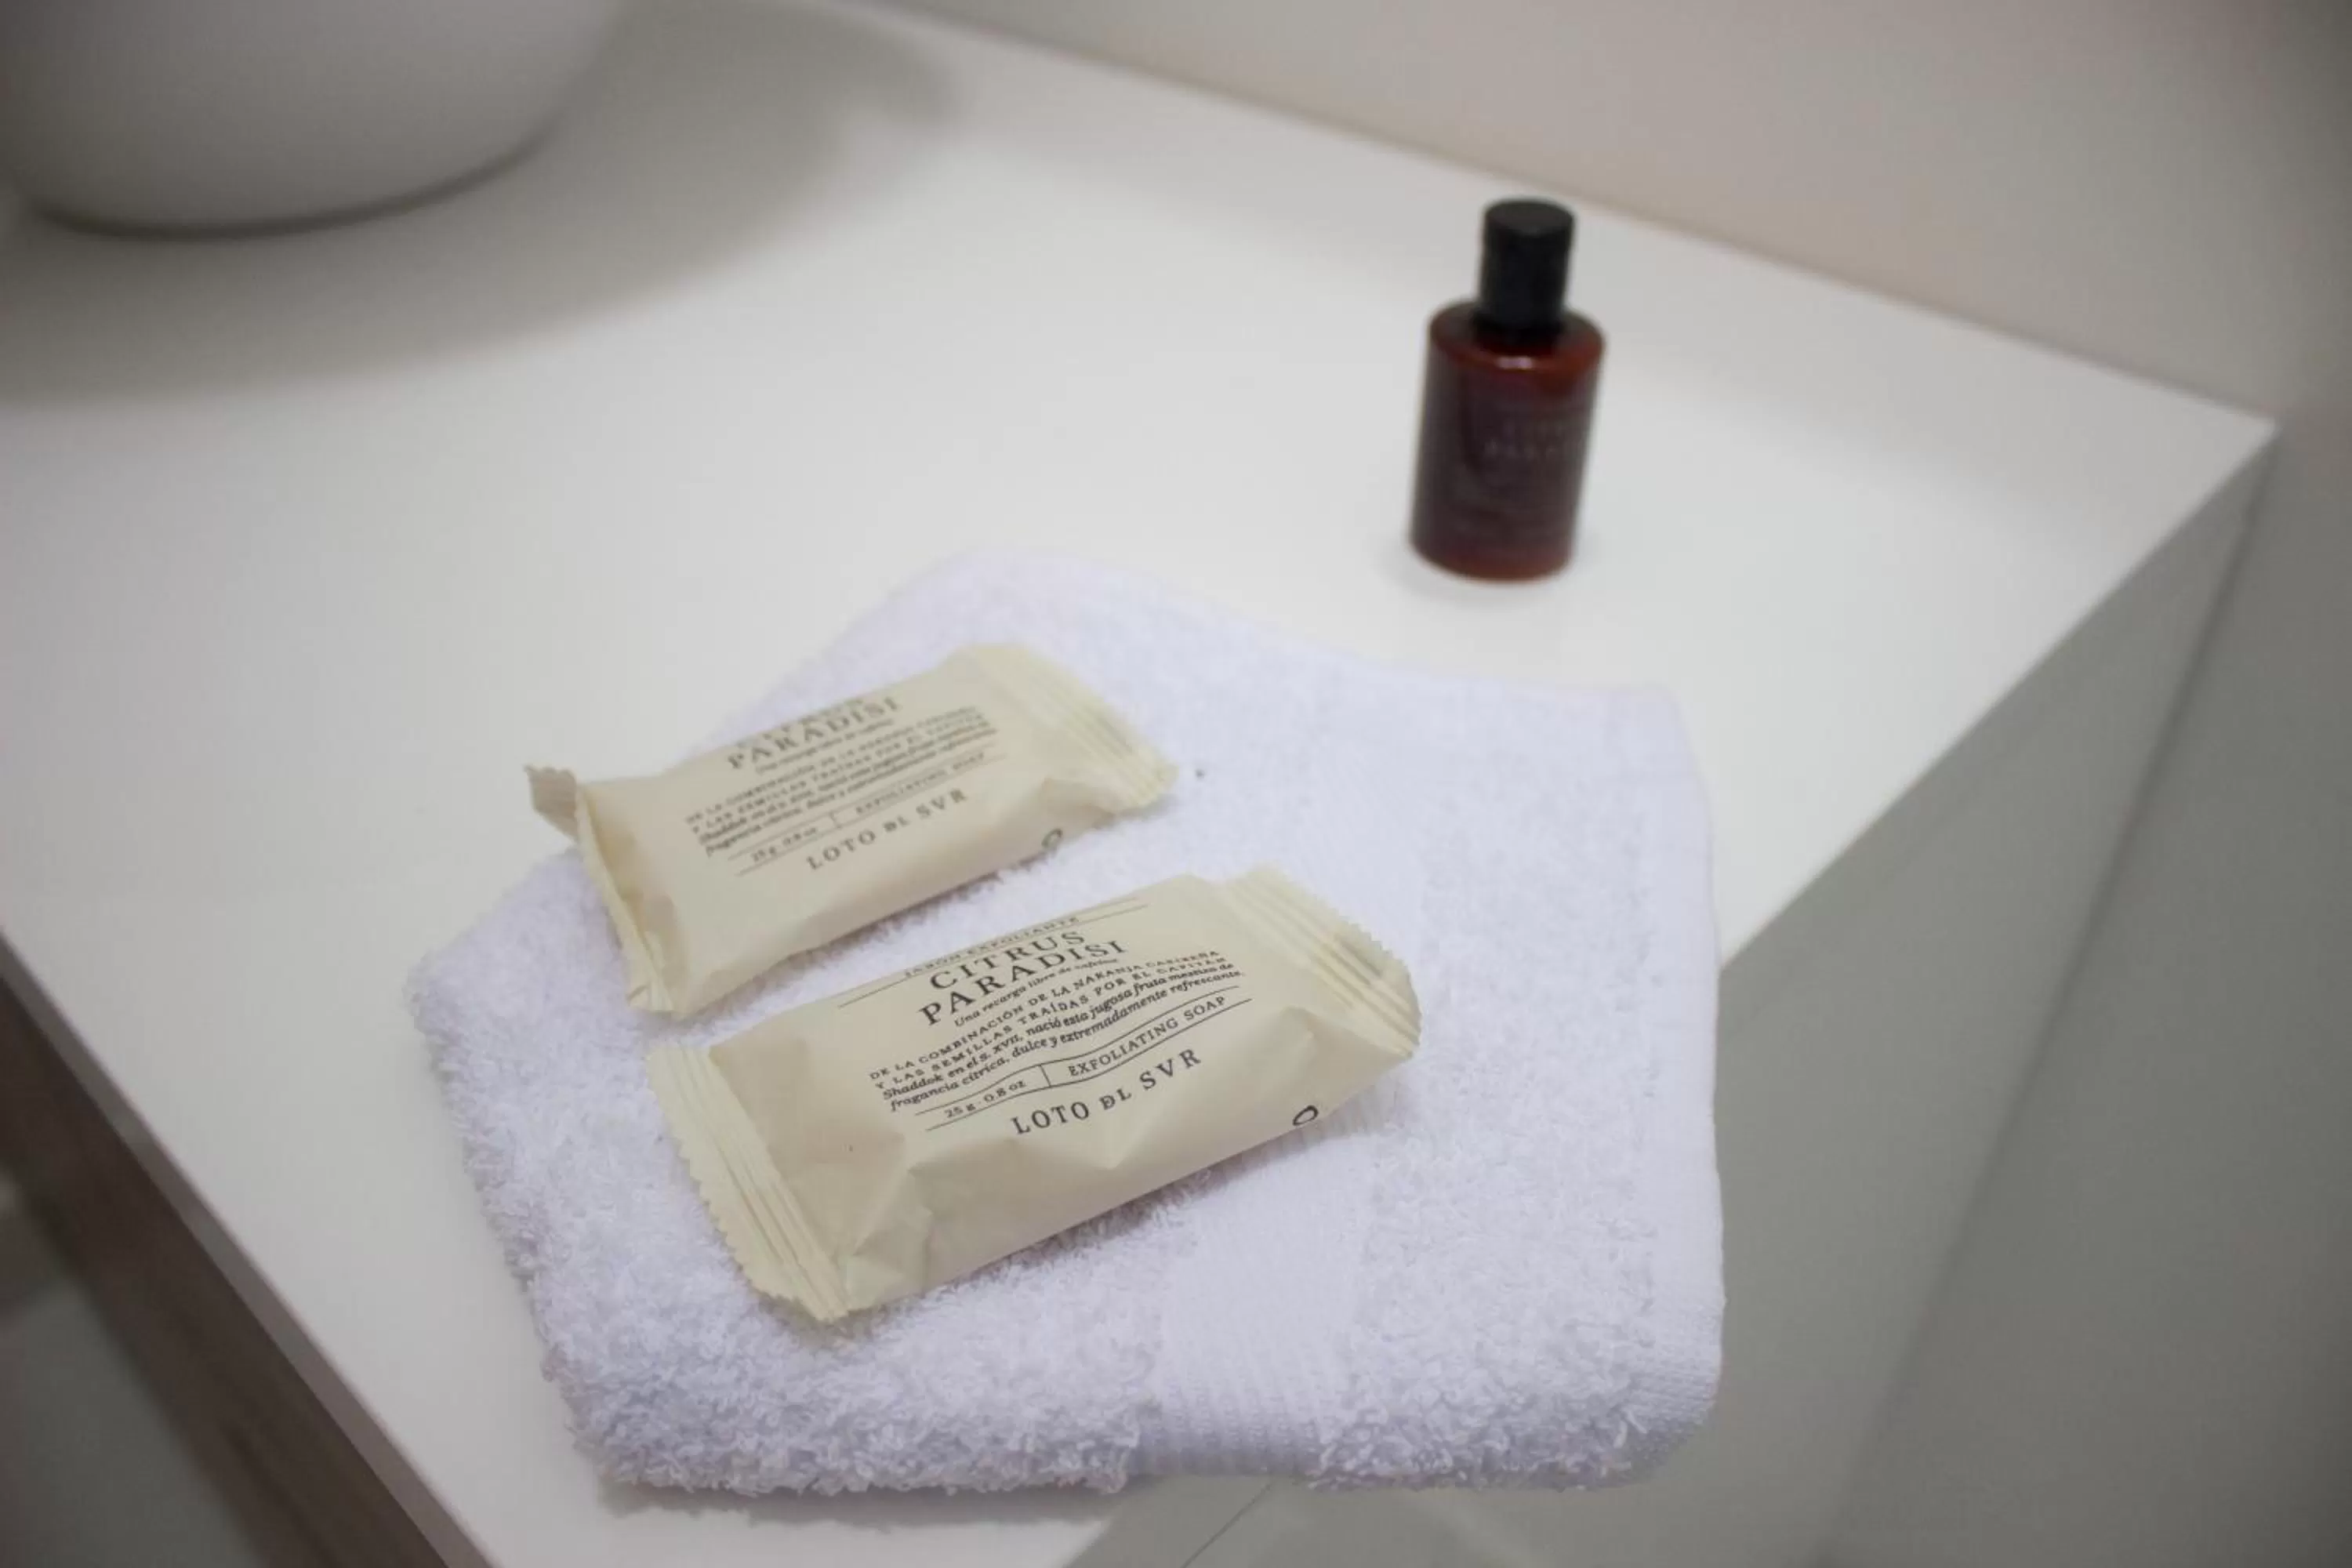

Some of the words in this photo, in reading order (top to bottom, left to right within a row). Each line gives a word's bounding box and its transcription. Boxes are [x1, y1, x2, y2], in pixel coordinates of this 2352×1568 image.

[727, 696, 899, 768] PARADISI
[806, 829, 876, 870] LOTO
[917, 940, 1126, 1025] PARADISI
[931, 931, 1085, 989] CITRUS
[869, 1067, 891, 1080] DE
[895, 1060, 915, 1071] LA
[1029, 993, 1047, 1006] DE
[1051, 985, 1071, 998] LA
[893, 1069, 925, 1084] LAS
[931, 1025, 1013, 1072] SEMILLAS
[1094, 978, 1127, 996] POR
[1025, 1018, 1062, 1036] nació
[1133, 978, 1167, 997] fruta
[1068, 1017, 1178, 1076] EXFOLIATING
[1183, 996, 1225, 1021] SOAP
[891, 1081, 960, 1112] fragancia
[1011, 1038, 1048, 1058] dulce
[1048, 1036, 1058, 1048] y
[1011, 1101, 1090, 1134] LOTO
[1139, 1049, 1201, 1090] SVR
